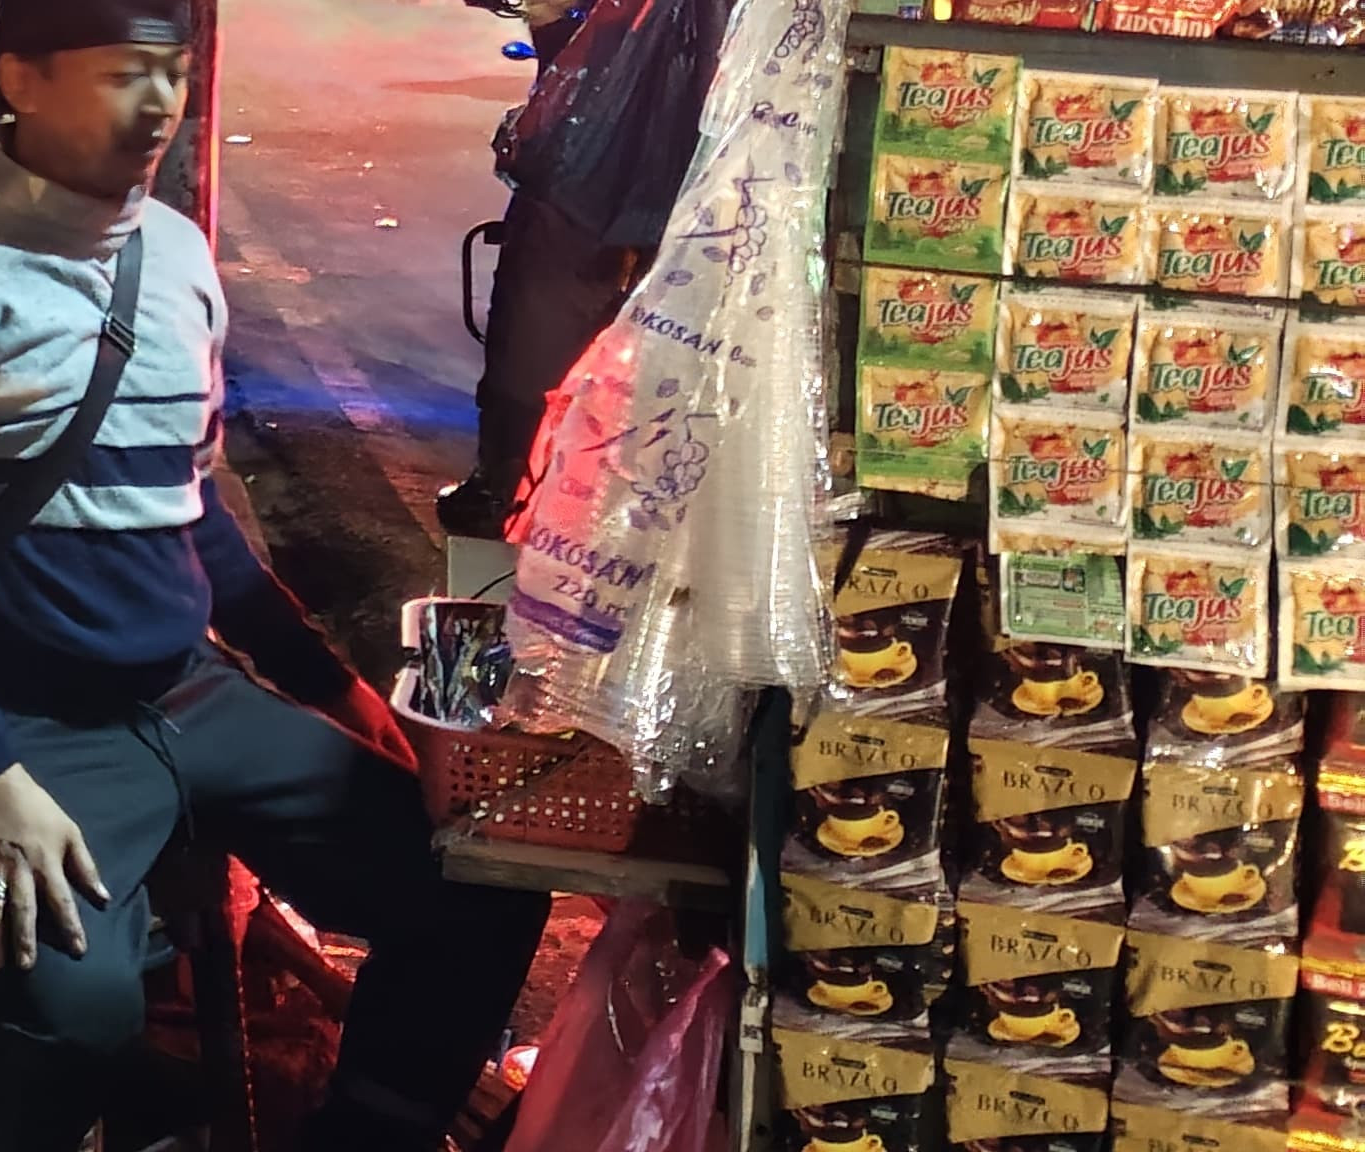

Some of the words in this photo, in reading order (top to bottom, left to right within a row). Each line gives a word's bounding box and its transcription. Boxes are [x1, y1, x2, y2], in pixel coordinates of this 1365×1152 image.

[900, 82, 996, 115] Teajus
[1033, 117, 1134, 153] Teajus
[1168, 131, 1271, 168] Teajus
[887, 191, 982, 227] Teajus
[1024, 232, 1124, 268] Teajus
[1160, 248, 1264, 285] Teajus
[878, 298, 974, 333] Teajus
[1016, 345, 1113, 380] Teajus
[1151, 362, 1254, 397] Teajus
[873, 402, 969, 437] Teajus
[848, 576, 929, 599] RAZCO
[1144, 593, 1243, 632] Teajus
[819, 740, 916, 769] BRAZCO
[1003, 770, 1106, 801] BRAZCO
[809, 905, 904, 944] BRAZCO
[991, 934, 1092, 968] BRAZCO
[802, 1060, 899, 1094] BRAZCO
[978, 1093, 1080, 1133] BRAZCO
